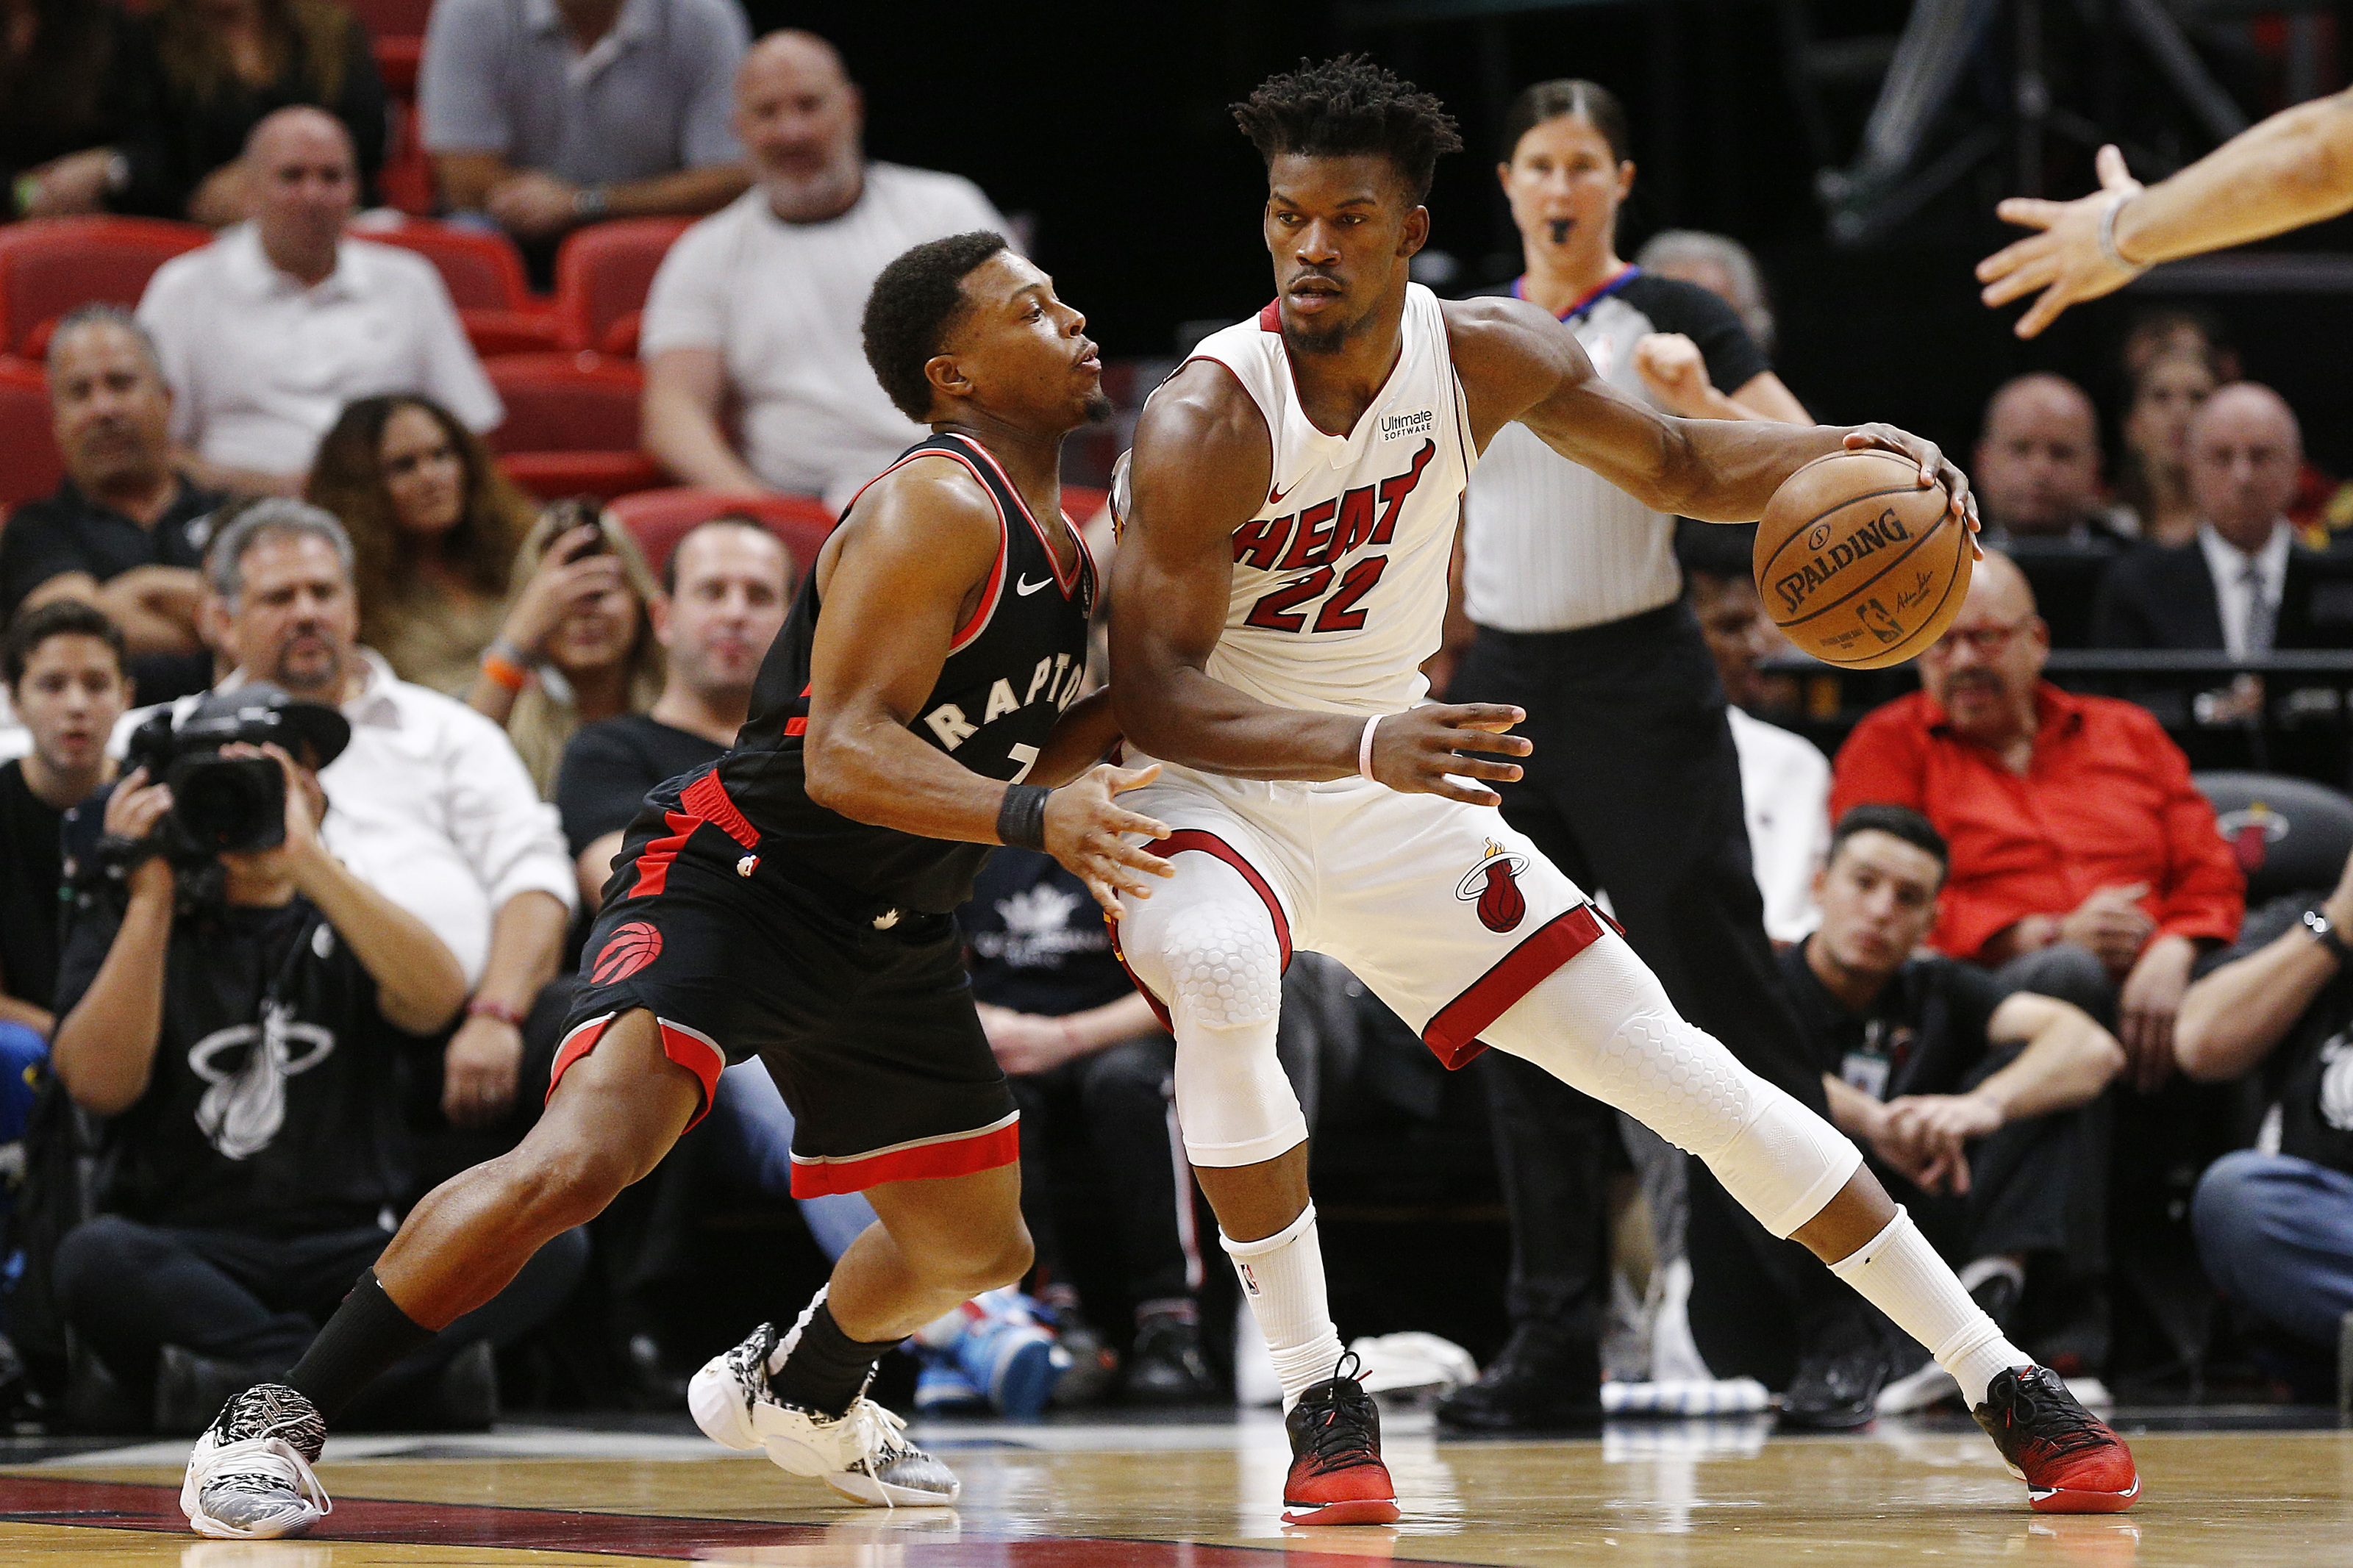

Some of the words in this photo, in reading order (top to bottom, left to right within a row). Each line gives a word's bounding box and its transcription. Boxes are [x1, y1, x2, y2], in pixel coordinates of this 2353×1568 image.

[1381, 409, 1432, 432] Ultimate
[1385, 423, 1431, 441] SOFTWARE
[1232, 437, 1436, 572] HEAT
[1775, 507, 1910, 615] SPALDING
[1243, 554, 1389, 634] 22
[1007, 742, 1040, 785] 7
